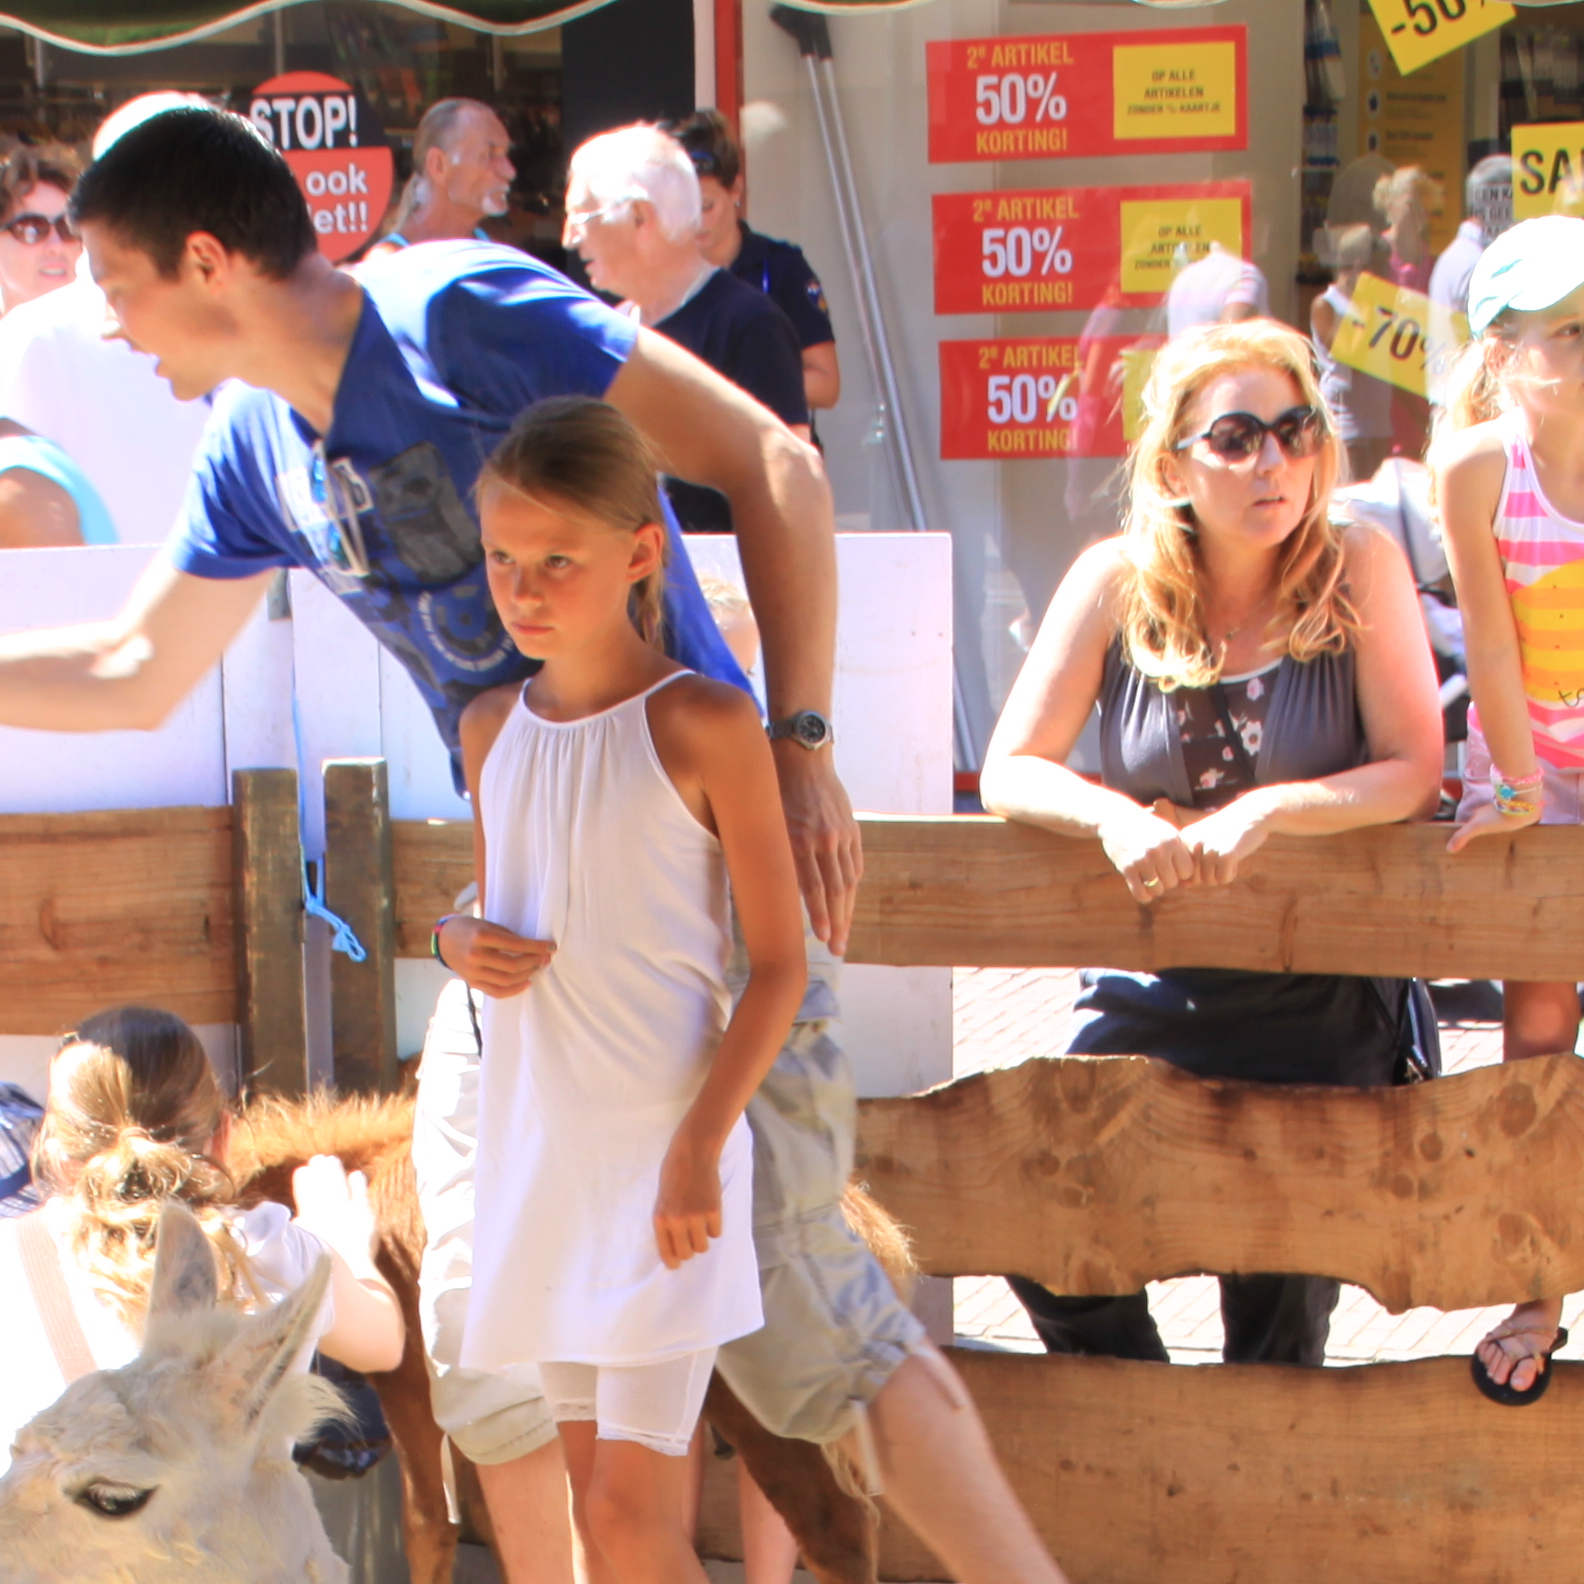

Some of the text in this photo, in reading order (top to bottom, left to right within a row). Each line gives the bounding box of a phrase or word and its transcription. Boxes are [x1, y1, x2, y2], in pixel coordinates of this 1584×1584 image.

[991, 42, 1075, 68] ARTIKEL
[1168, 68, 1196, 82] ALLE
[975, 72, 1068, 125] 50%
[1143, 85, 1205, 100] ARTIKELEN
[249, 94, 359, 150] STOP!
[976, 127, 1068, 154] KORTING!
[996, 195, 1080, 221] ARTIKEL
[1175, 224, 1202, 238] ALLE
[982, 225, 1073, 278] 50%
[982, 282, 1074, 306] KORTING!
[1351, 305, 1447, 376] -70%
[1002, 344, 1084, 368] ARTIKEL
[986, 372, 1079, 424] 50%
